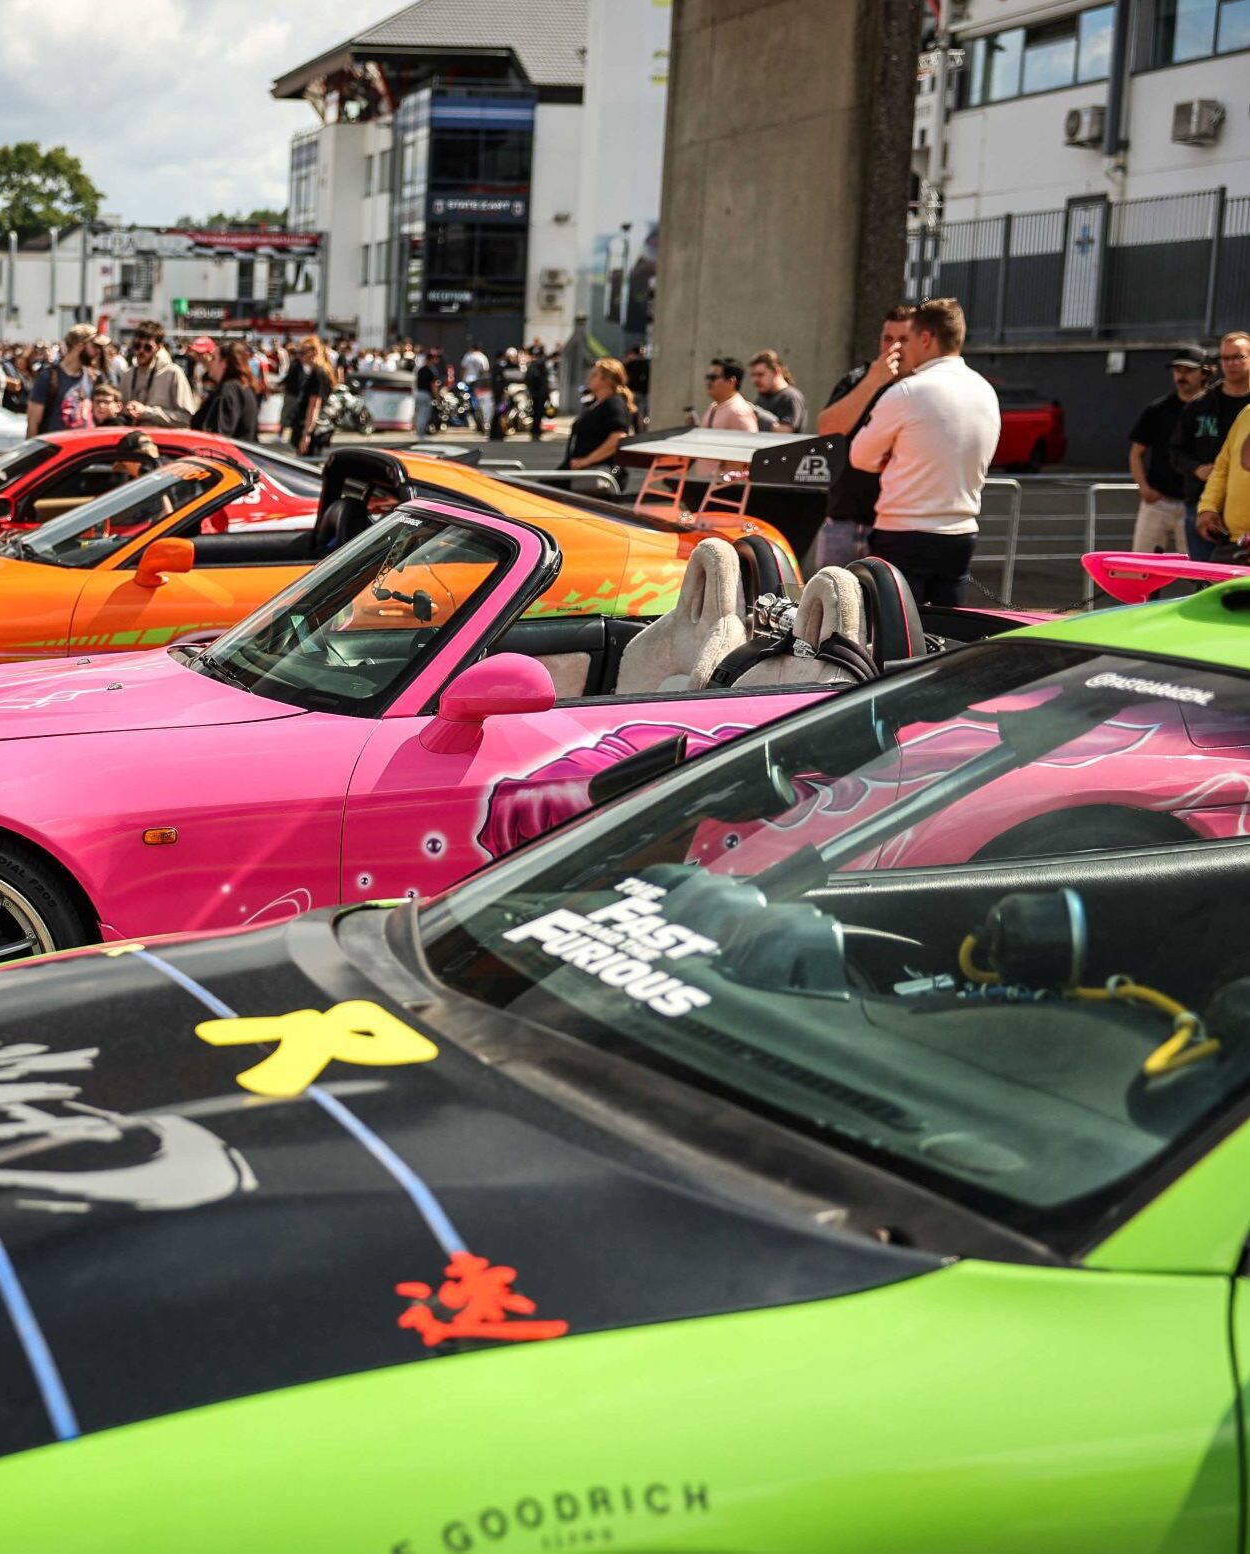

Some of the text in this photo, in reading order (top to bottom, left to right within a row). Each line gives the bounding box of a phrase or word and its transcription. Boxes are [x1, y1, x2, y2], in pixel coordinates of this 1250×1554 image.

[614, 877, 667, 900] THE
[586, 895, 719, 960] FAST
[502, 908, 712, 1017] FURIOUS
[441, 1482, 710, 1553] GOODRICH
